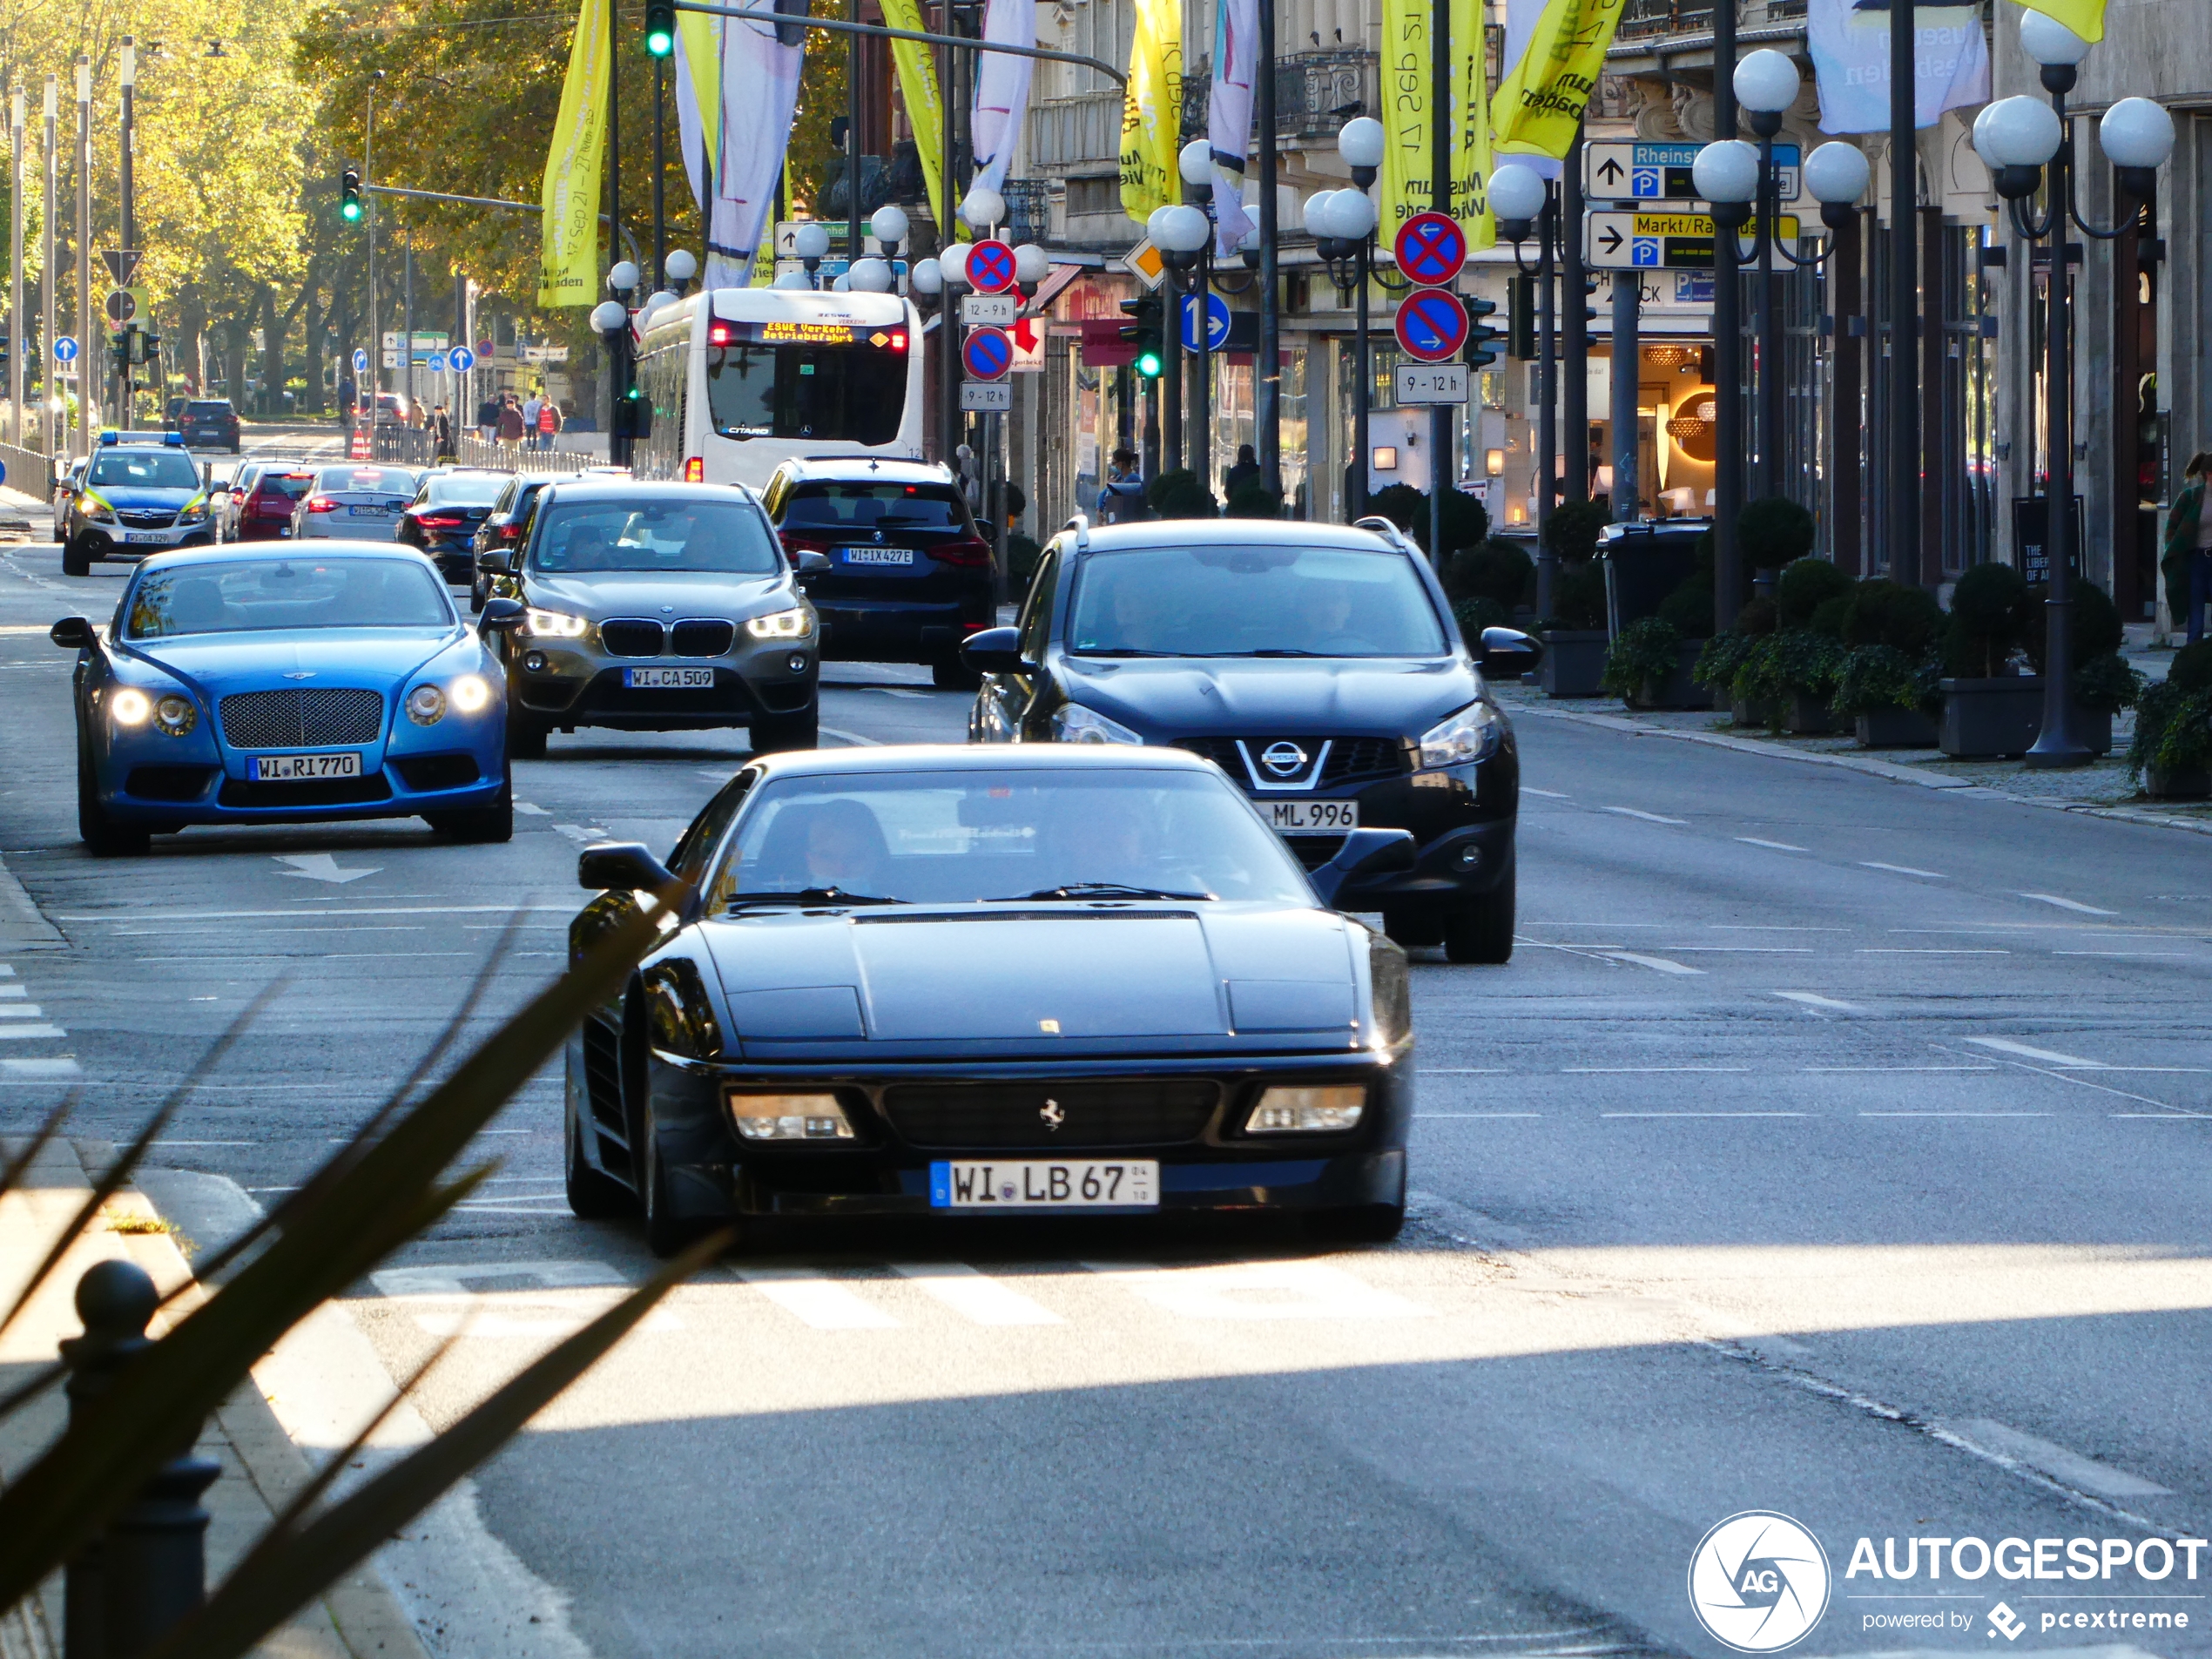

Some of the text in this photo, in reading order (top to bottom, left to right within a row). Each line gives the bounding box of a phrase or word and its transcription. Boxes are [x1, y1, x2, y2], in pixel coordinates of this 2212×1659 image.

[572, 191, 589, 206] 21
[569, 211, 586, 239] Sep
[970, 305, 981, 315] 12
[992, 305, 999, 315] 9
[1001, 305, 1007, 314] h
[767, 322, 850, 334] ESWE Verkehr
[762, 331, 853, 342] Betriebsfahrt
[1408, 376, 1415, 391] 9
[1433, 376, 1445, 391] 12
[1450, 375, 1457, 391] h
[968, 392, 974, 401] 9
[987, 392, 995, 401] 12
[998, 391, 1003, 401] h
[851, 550, 863, 561] WI
[870, 550, 882, 562] IX
[2025, 545, 2042, 556] THE
[2027, 570, 2038, 581] OF
[632, 671, 711, 685] WI CA 509
[259, 756, 354, 778] WI RI 770
[1273, 804, 1352, 826] ML 996
[954, 1166, 996, 1202] WI
[1023, 1166, 1072, 1202] LB
[1081, 1166, 1124, 1201] 67
